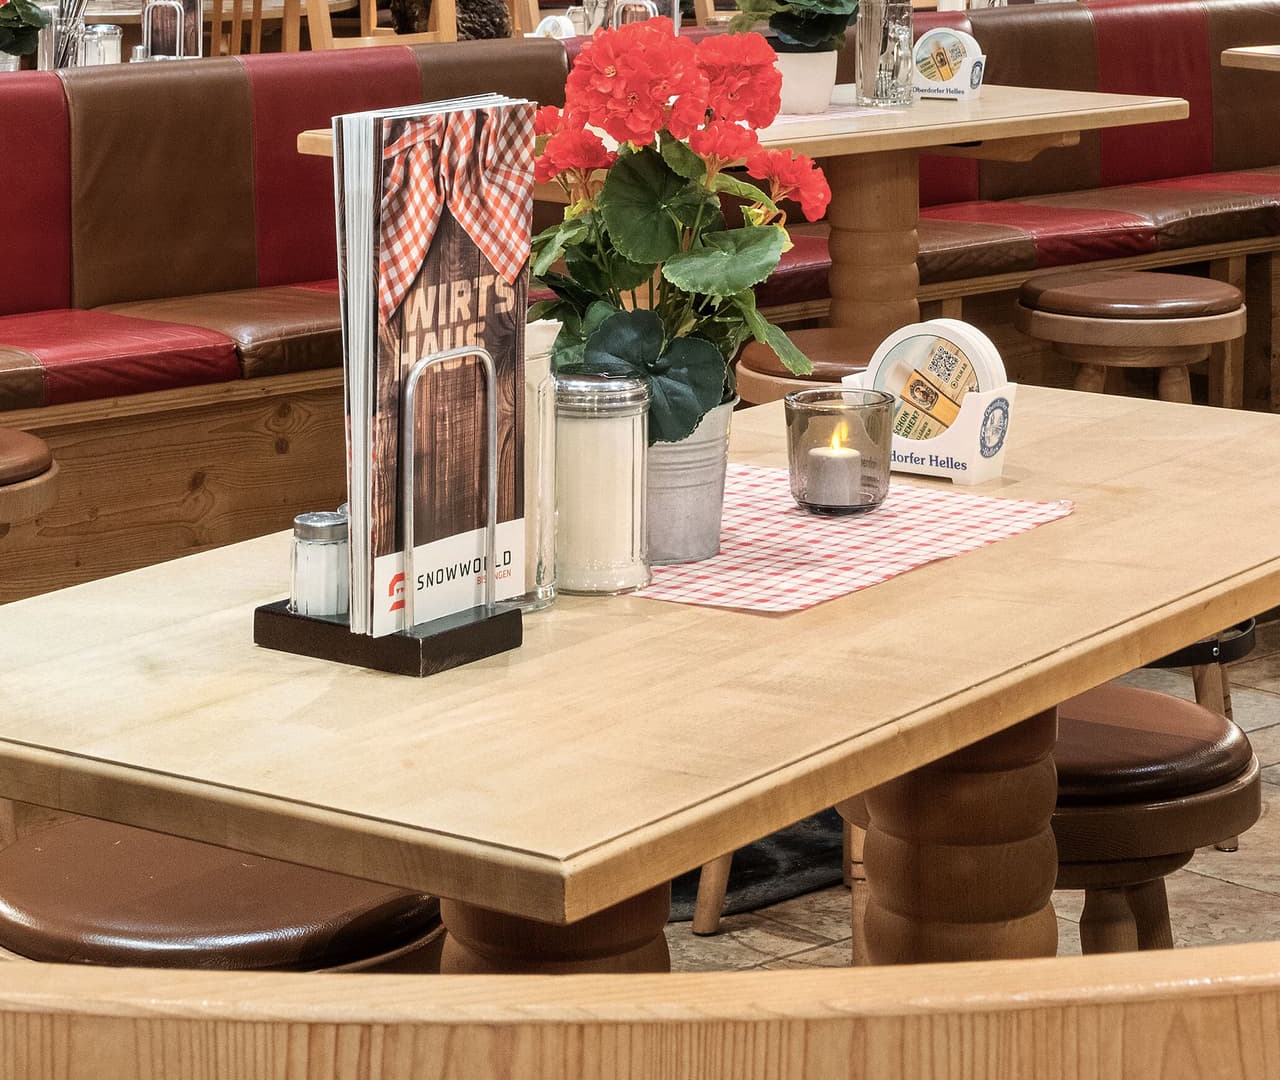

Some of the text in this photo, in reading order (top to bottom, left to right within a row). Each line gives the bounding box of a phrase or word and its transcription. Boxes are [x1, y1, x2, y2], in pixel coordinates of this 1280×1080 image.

[403, 274, 516, 332] WIRTS
[394, 321, 486, 381] HAUS
[902, 410, 920, 439] SEHEN?
[891, 450, 926, 466] dorfer
[929, 455, 967, 471] Helles
[417, 550, 512, 591] SNOWWOD
[476, 569, 512, 585] BISNGEN
